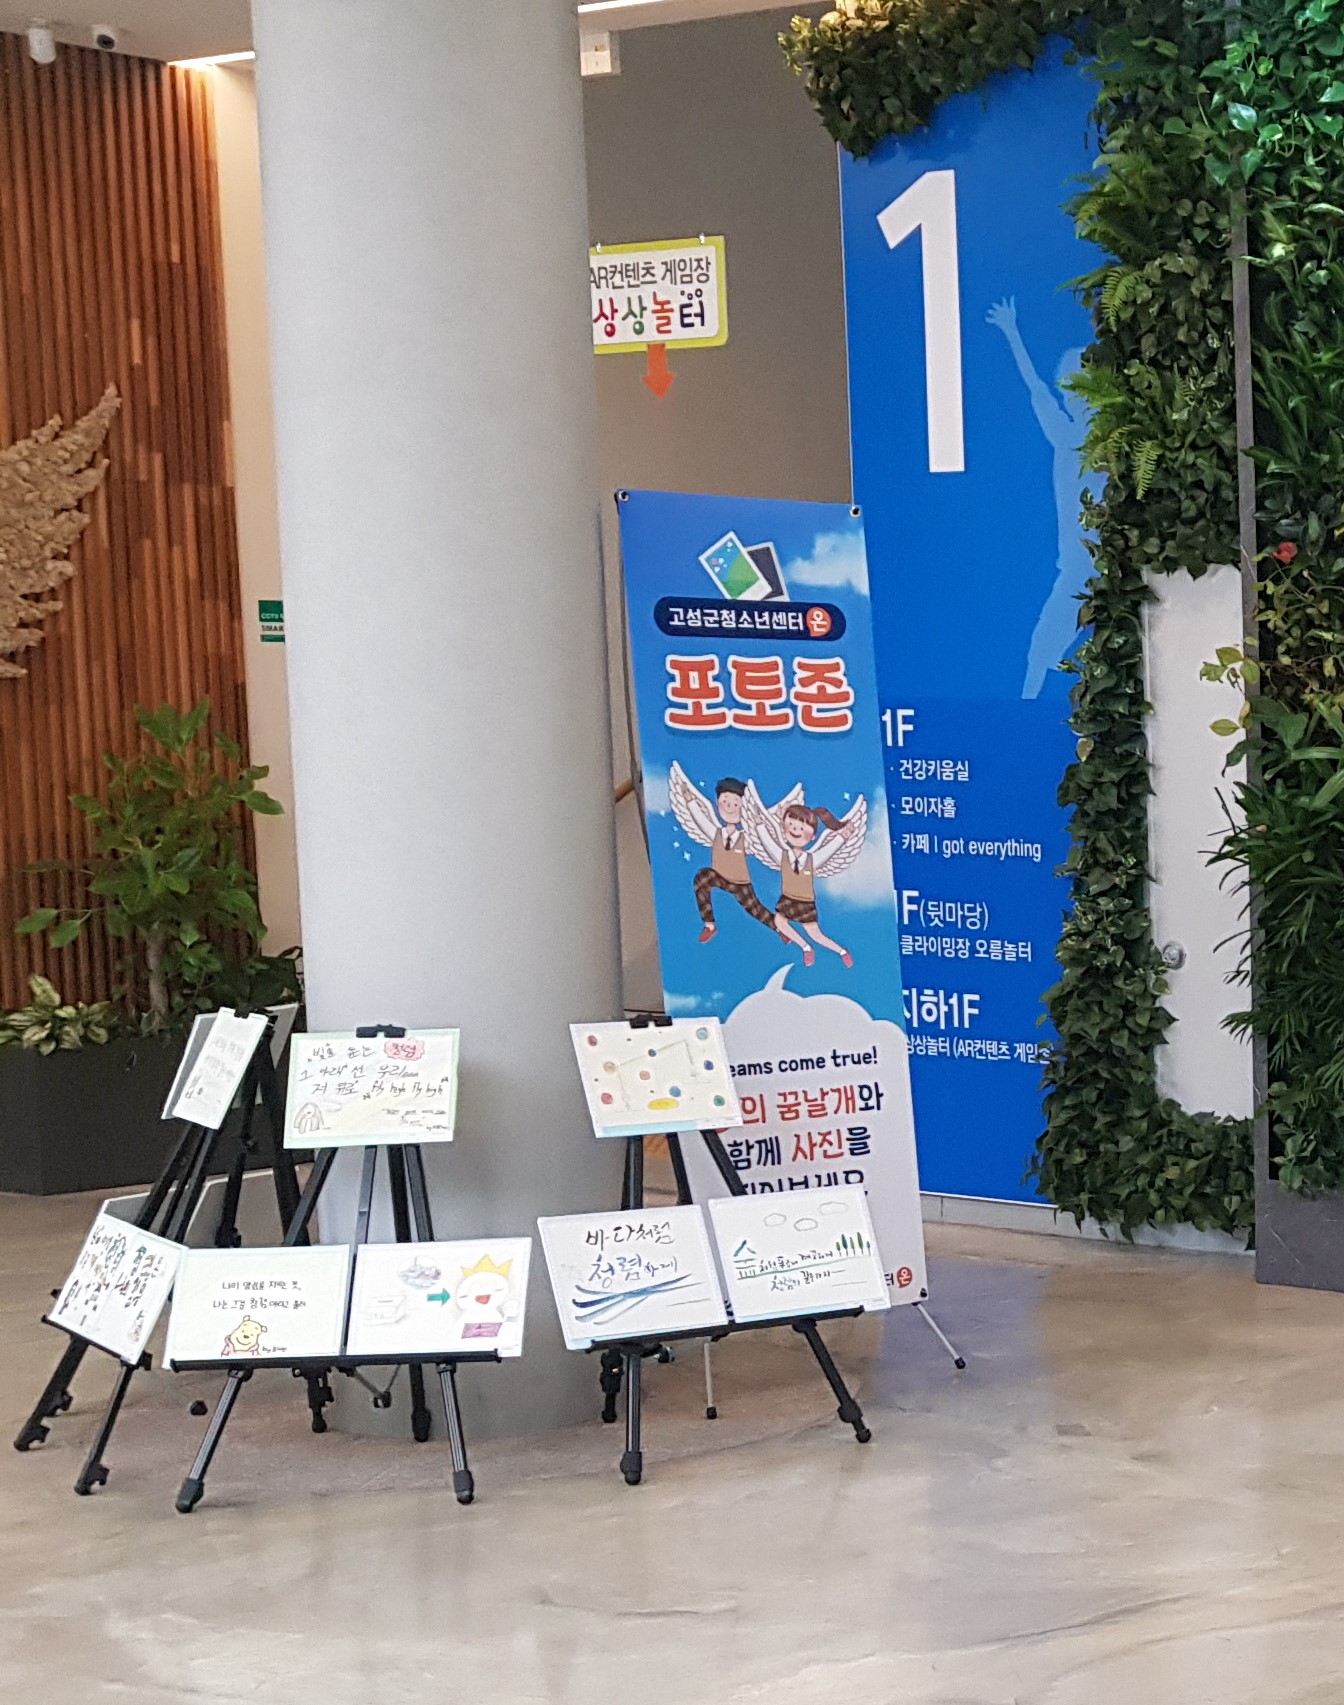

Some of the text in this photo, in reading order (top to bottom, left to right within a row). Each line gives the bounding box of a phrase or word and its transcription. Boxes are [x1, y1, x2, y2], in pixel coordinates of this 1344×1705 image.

[660, 256, 711, 285] 게임장
[593, 289, 705, 337] 상상놀터
[876, 169, 965, 473] 1
[668, 607, 804, 631] 고성군청소년센터
[665, 653, 854, 733] 포토존
[881, 708, 915, 747] 1F
[899, 759, 970, 782] 건강키움실
[900, 796, 957, 818] 모이자홀
[901, 833, 930, 854] 카페
[942, 837, 965, 858] got
[968, 838, 1042, 862] everything
[900, 934, 1032, 963] 클라이밍장 오름놀터
[778, 1055, 826, 1073] come
[831, 1046, 878, 1067] true!
[777, 1082, 884, 1122] 꿈날개와
[728, 1126, 871, 1171] 함께 사진을
[586, 1221, 676, 1251] 바다처럼
